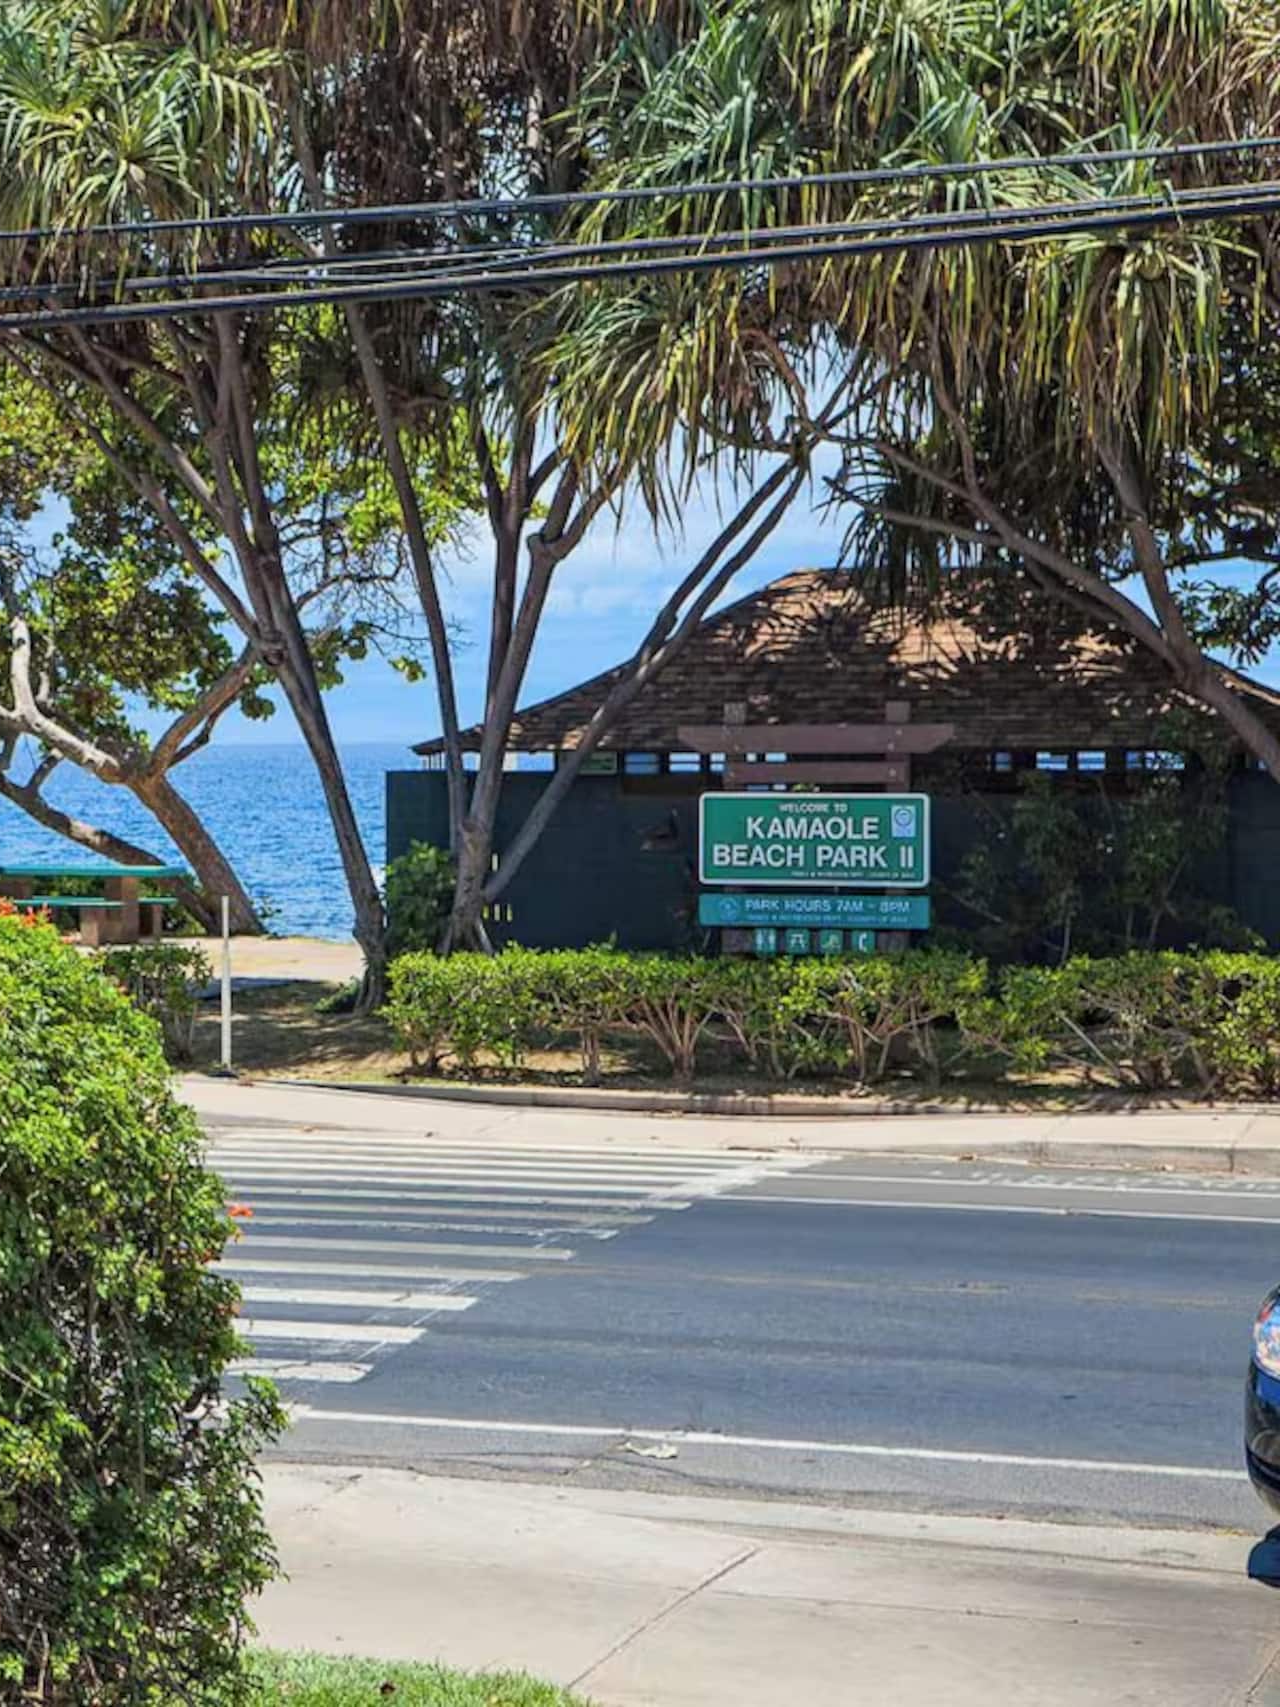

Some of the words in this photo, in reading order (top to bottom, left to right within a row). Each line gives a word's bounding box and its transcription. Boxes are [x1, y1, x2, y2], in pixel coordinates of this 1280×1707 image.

[779, 803, 829, 813] WELCOME
[833, 803, 848, 813] TO
[746, 816, 880, 840] KAMAOLE
[712, 844, 804, 867] BEACH
[816, 845, 887, 868] PARK
[899, 845, 915, 868] II
[745, 899, 780, 911] PARK
[784, 900, 831, 912] HOURS
[836, 901, 864, 913] 7AM
